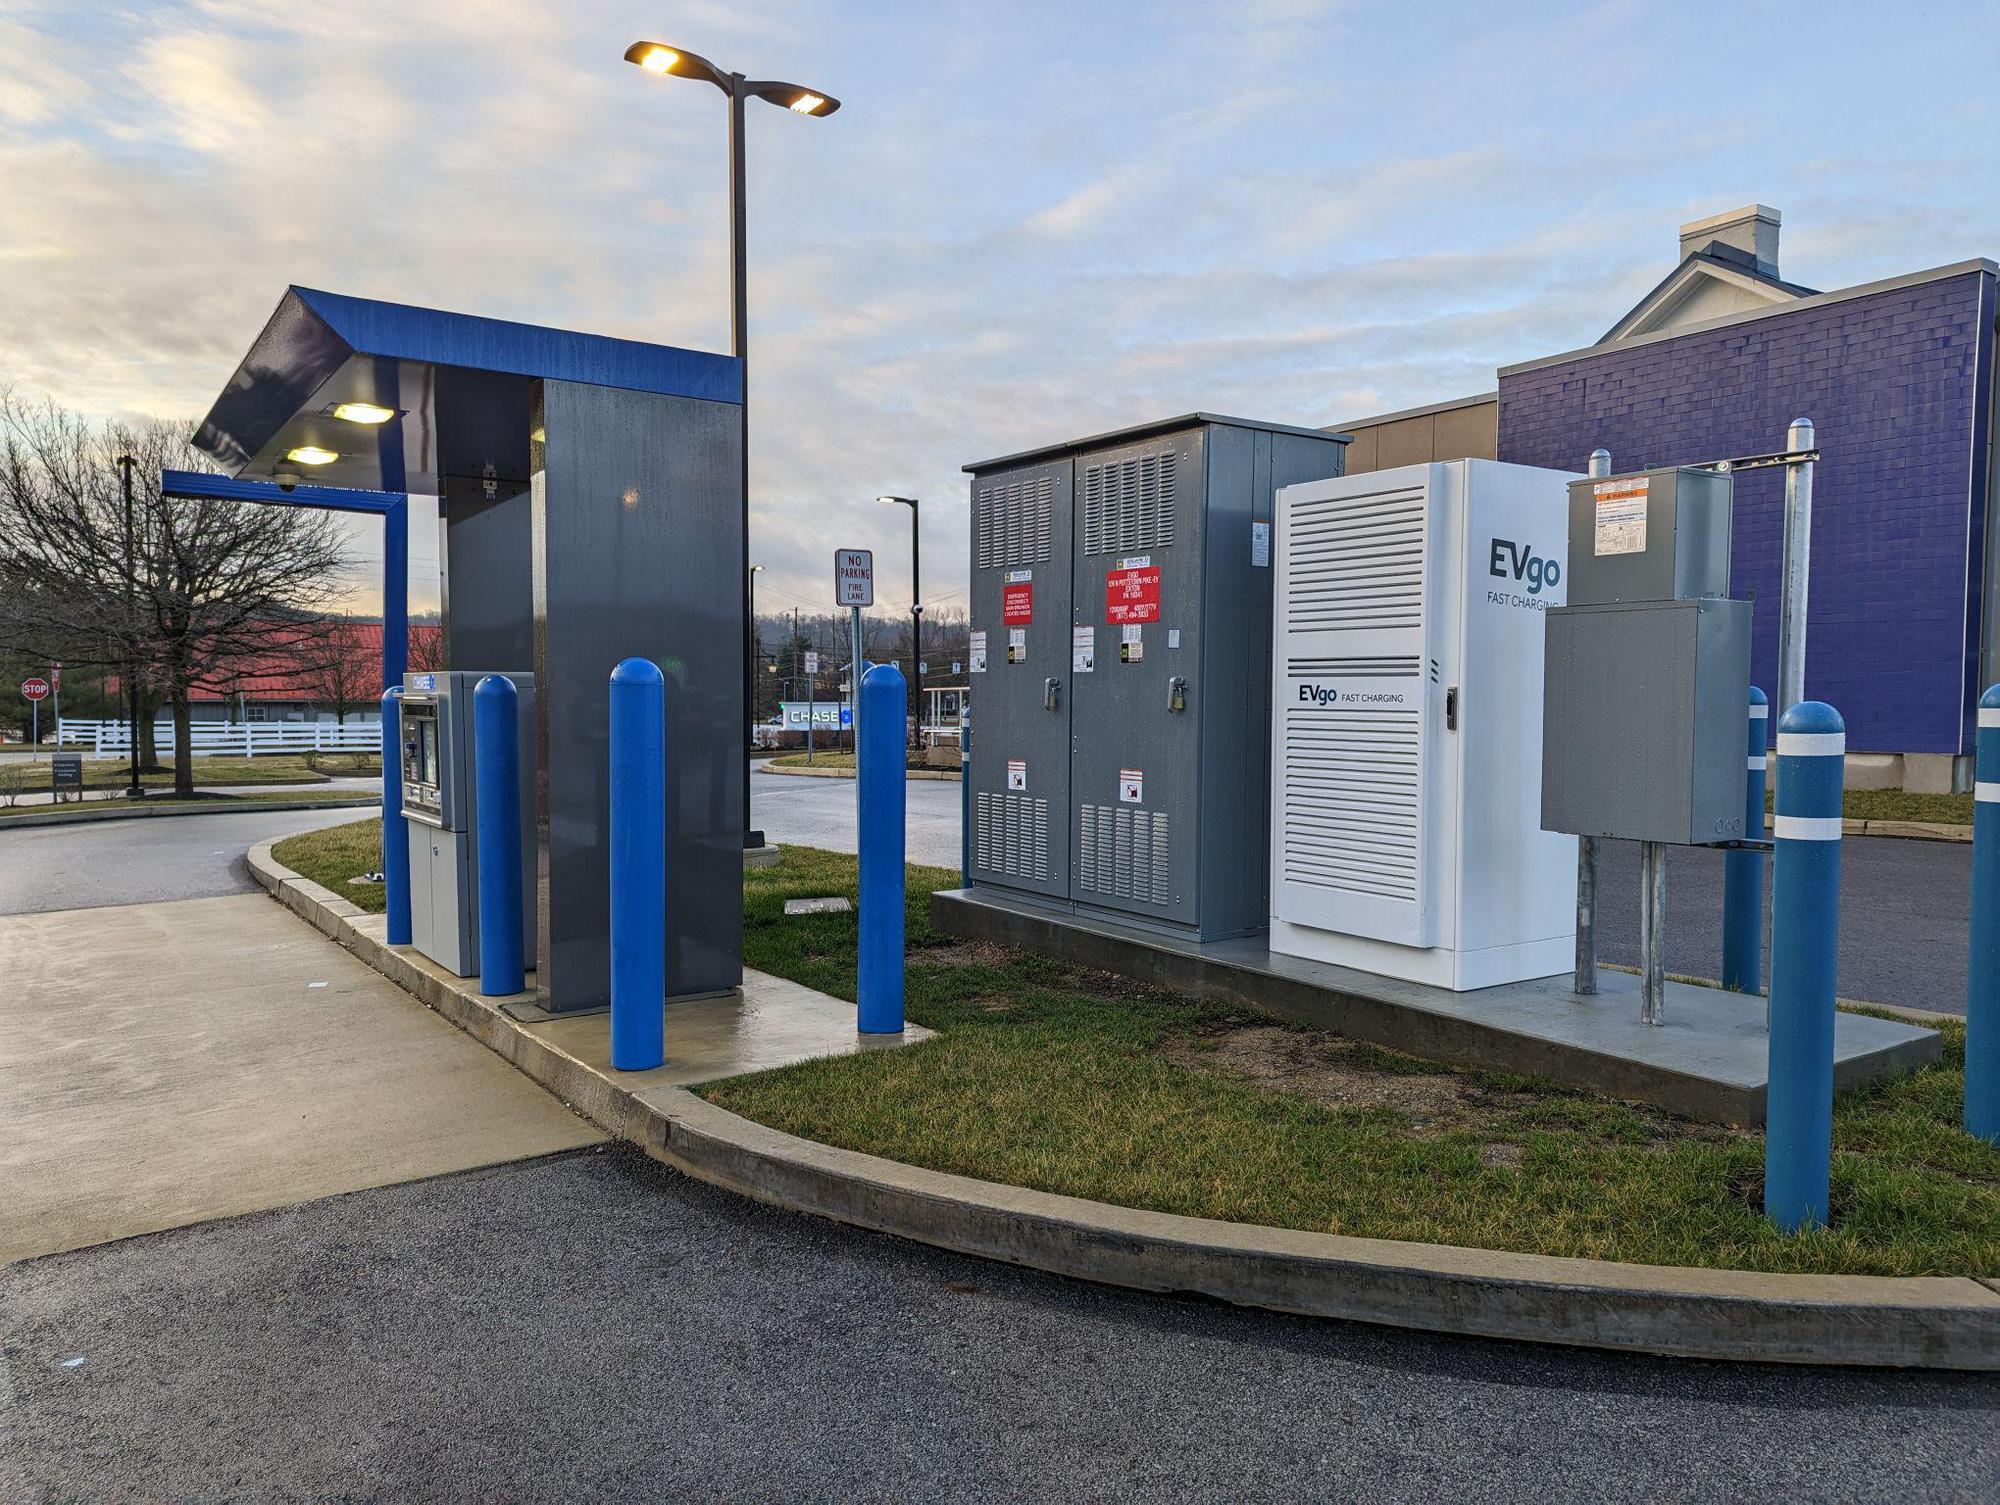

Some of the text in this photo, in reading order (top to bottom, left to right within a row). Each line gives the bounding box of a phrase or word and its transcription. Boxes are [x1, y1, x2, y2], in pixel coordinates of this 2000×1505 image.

[1612, 490, 1638, 498] WARNING
[848, 555, 861, 566] NO
[1490, 538, 1560, 594] EVgo
[840, 568, 870, 579] PARKING
[848, 583, 863, 591] FIRE
[847, 592, 865, 600] LANE
[1487, 591, 1510, 606] FAST
[24, 685, 47, 694] STOP
[1299, 685, 1404, 706] EVgo FAST CHARGING
[790, 711, 839, 722] CHASE
